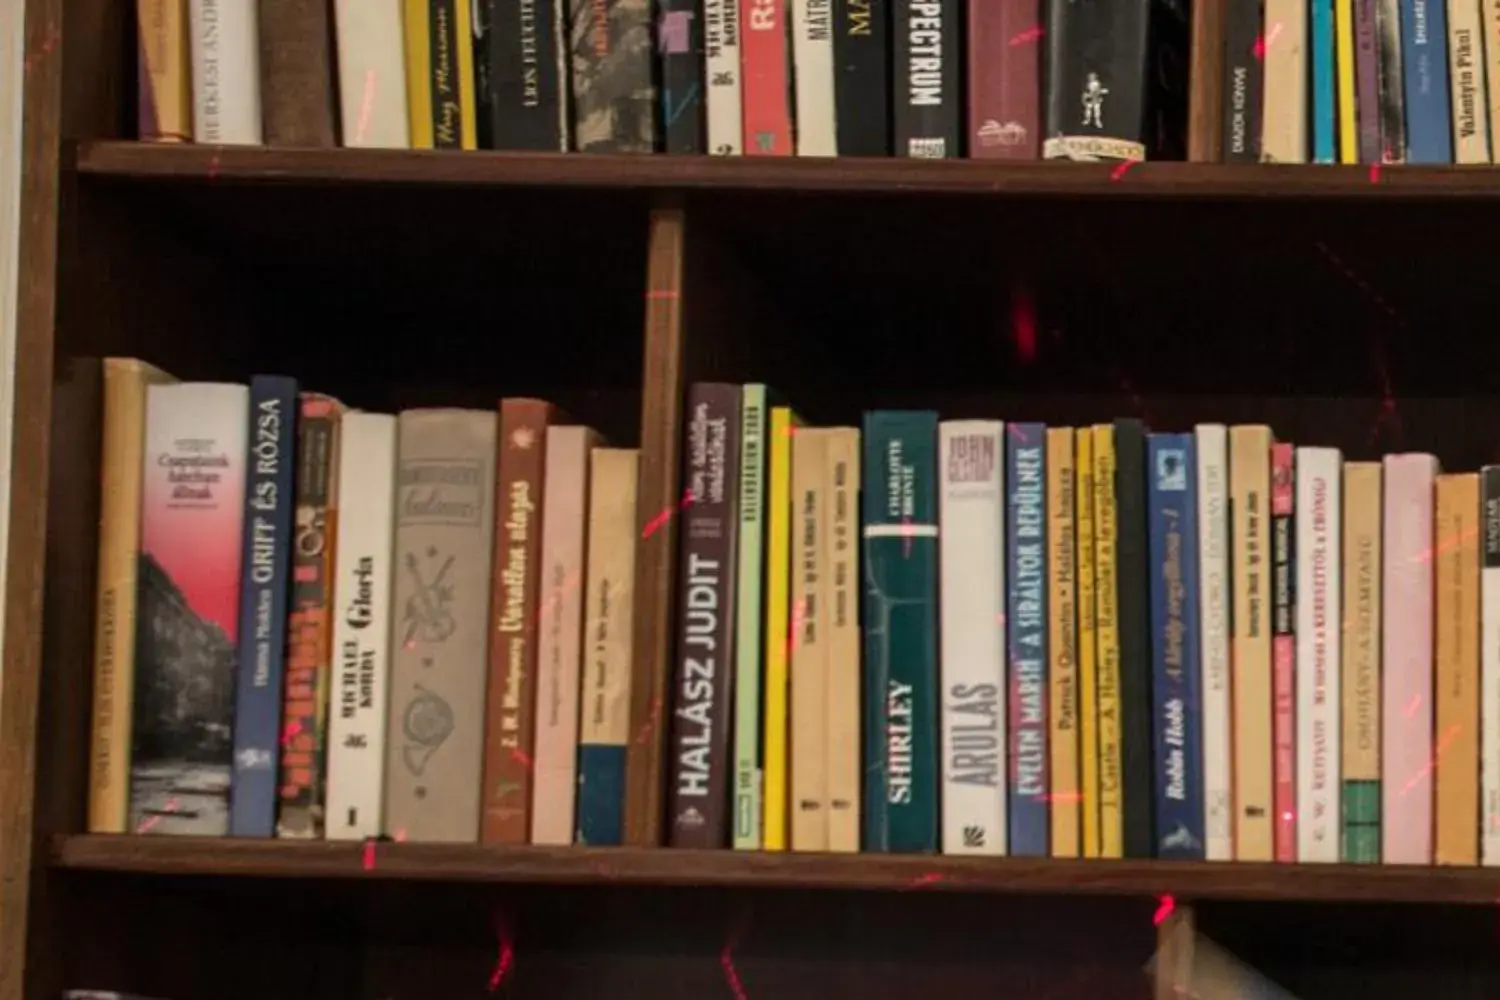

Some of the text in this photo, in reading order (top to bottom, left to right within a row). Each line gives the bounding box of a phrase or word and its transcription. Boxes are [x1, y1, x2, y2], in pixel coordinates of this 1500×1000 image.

[1456, 28, 1473, 67] Pikul
[256, 398, 282, 474] RÓZSA
[250, 480, 277, 512] ÉS
[887, 438, 903, 516] CHARLOTTE
[1009, 447, 1041, 538] REPÜLNEK
[251, 515, 276, 584] GRIFF
[340, 555, 374, 720] MICHAEL Gloria
[675, 552, 719, 797] HALÁSZ JUDIT
[946, 683, 999, 788] ÁRULÁS
[1057, 676, 1073, 730] Patrick
[1163, 698, 1185, 747] Hobb
[886, 679, 915, 805] SHIRLEY
[1165, 750, 1186, 801] Robin
